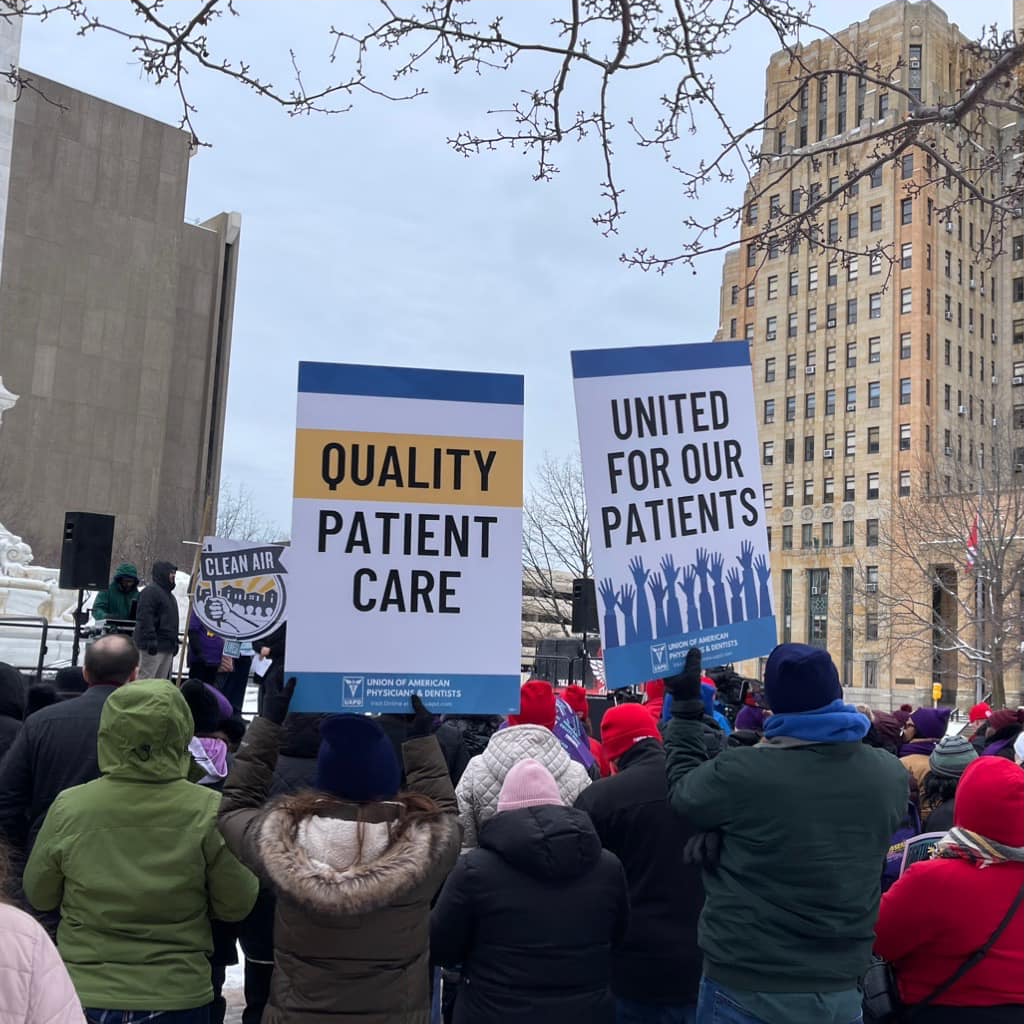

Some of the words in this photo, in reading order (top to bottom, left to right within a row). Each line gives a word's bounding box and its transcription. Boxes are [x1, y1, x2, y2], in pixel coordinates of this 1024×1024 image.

[611, 390, 730, 441] UNITED
[321, 442, 497, 491] QUALITY
[607, 447, 672, 494] FOR
[681, 439, 744, 484] OUR
[317, 509, 498, 558] PATIENT
[602, 487, 759, 548] PATIENTS
[205, 555, 248, 576] CLEAN
[253, 552, 274, 571] AIR
[353, 568, 461, 614] CARE
[668, 639, 689, 651] UNION
[689, 638, 698, 646] OF
[699, 632, 729, 644] AMERICAN
[711, 639, 738, 651] DENTISTS
[366, 688, 414, 697] PHYSICIANS
[416, 689, 423, 697] &
[424, 689, 461, 697] DENTISTS
[408, 679, 450, 687] AMERICAN
